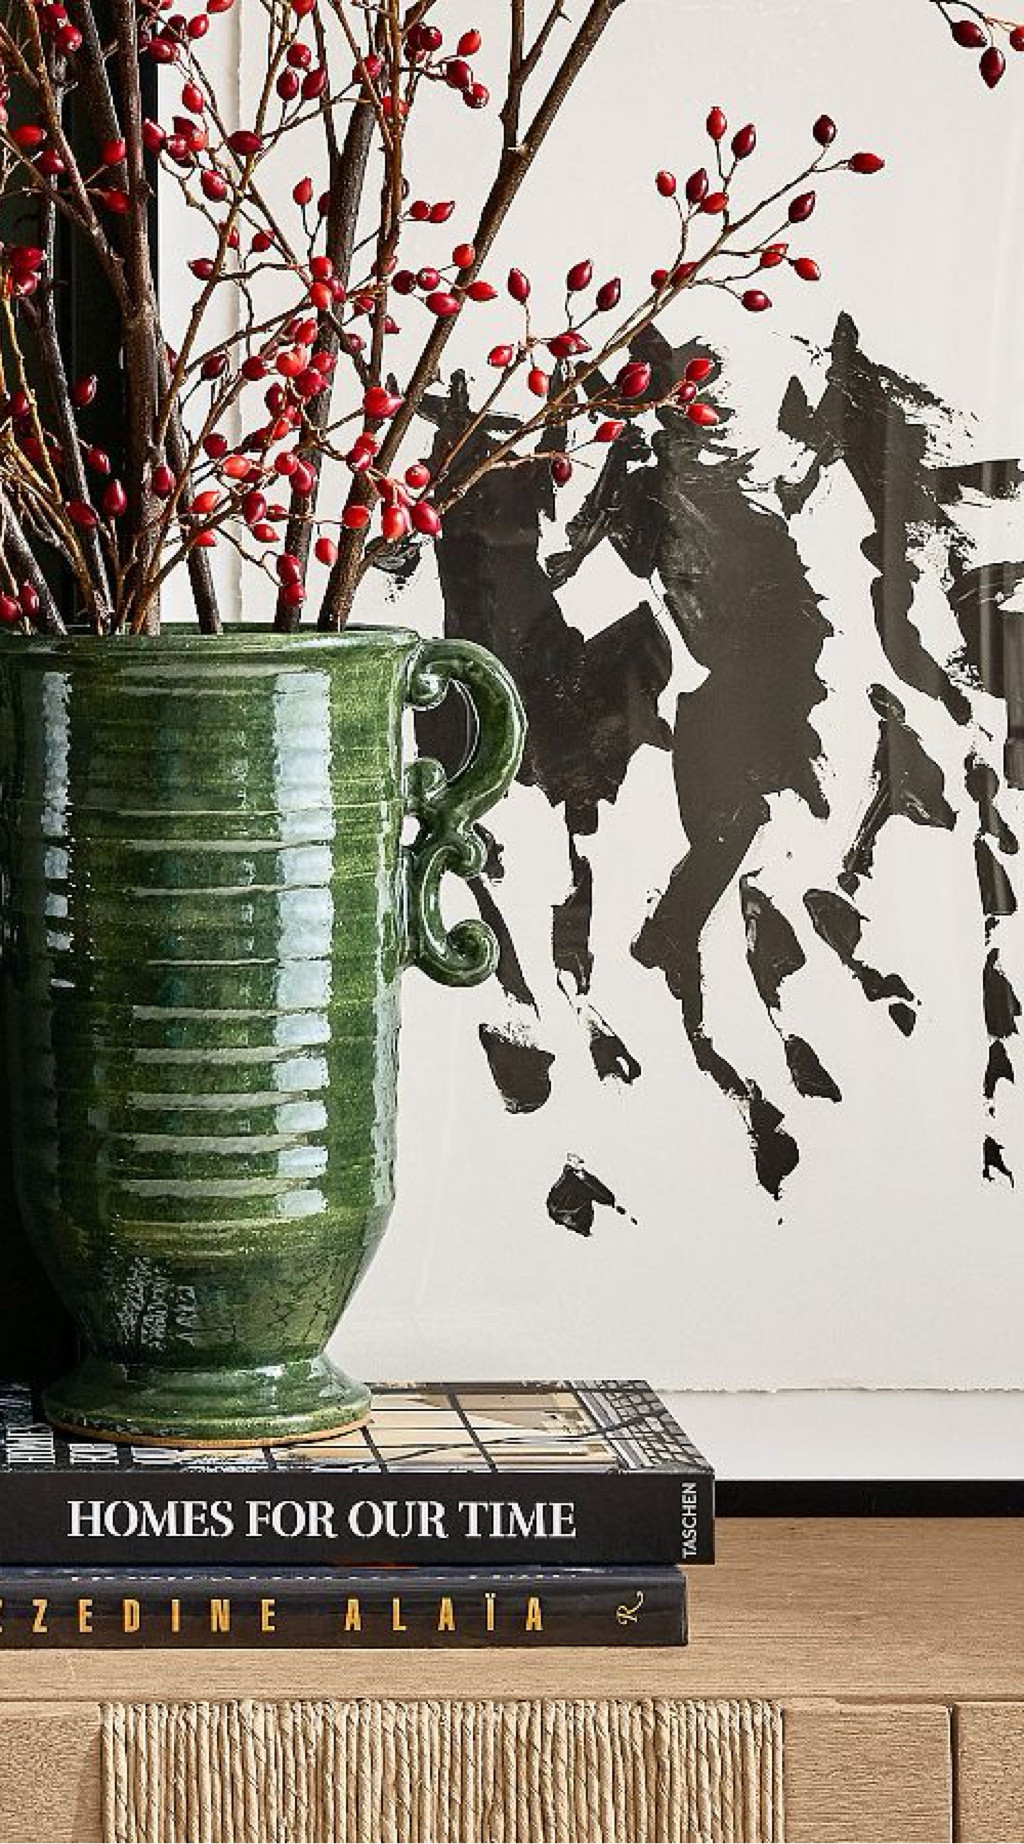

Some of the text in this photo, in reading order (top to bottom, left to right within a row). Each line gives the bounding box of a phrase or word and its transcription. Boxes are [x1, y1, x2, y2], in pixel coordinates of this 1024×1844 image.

[68, 1500, 577, 1538] HOMES FOR OUR TIME
[681, 1482, 697, 1559] TASCHEN
[344, 1592, 542, 1631] ALAÏA
